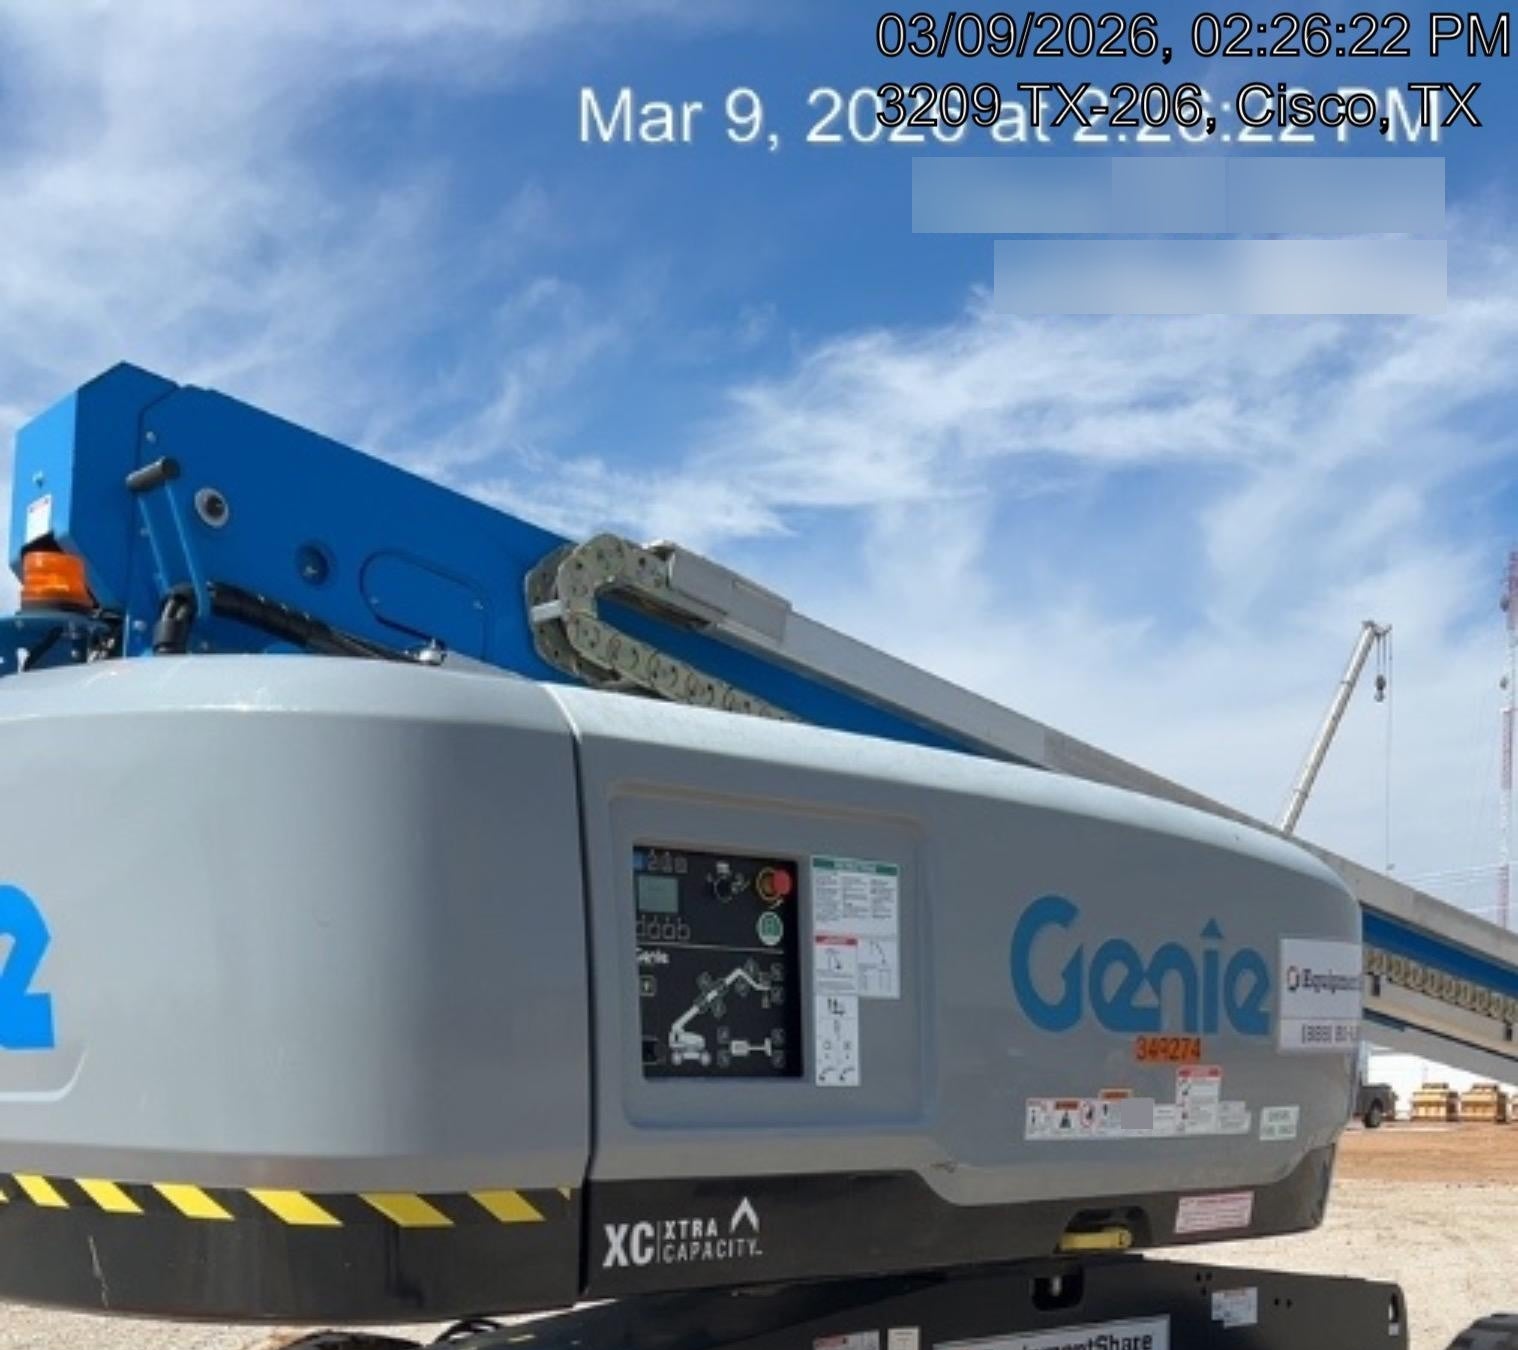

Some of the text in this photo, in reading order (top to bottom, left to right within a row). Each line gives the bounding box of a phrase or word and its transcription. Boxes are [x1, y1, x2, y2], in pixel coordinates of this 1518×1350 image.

[1010, 894, 1271, 1036] Genie
[603, 1220, 656, 1268] XC
[664, 1218, 719, 1241] XTRA
[662, 1238, 758, 1265] CAPACITY
